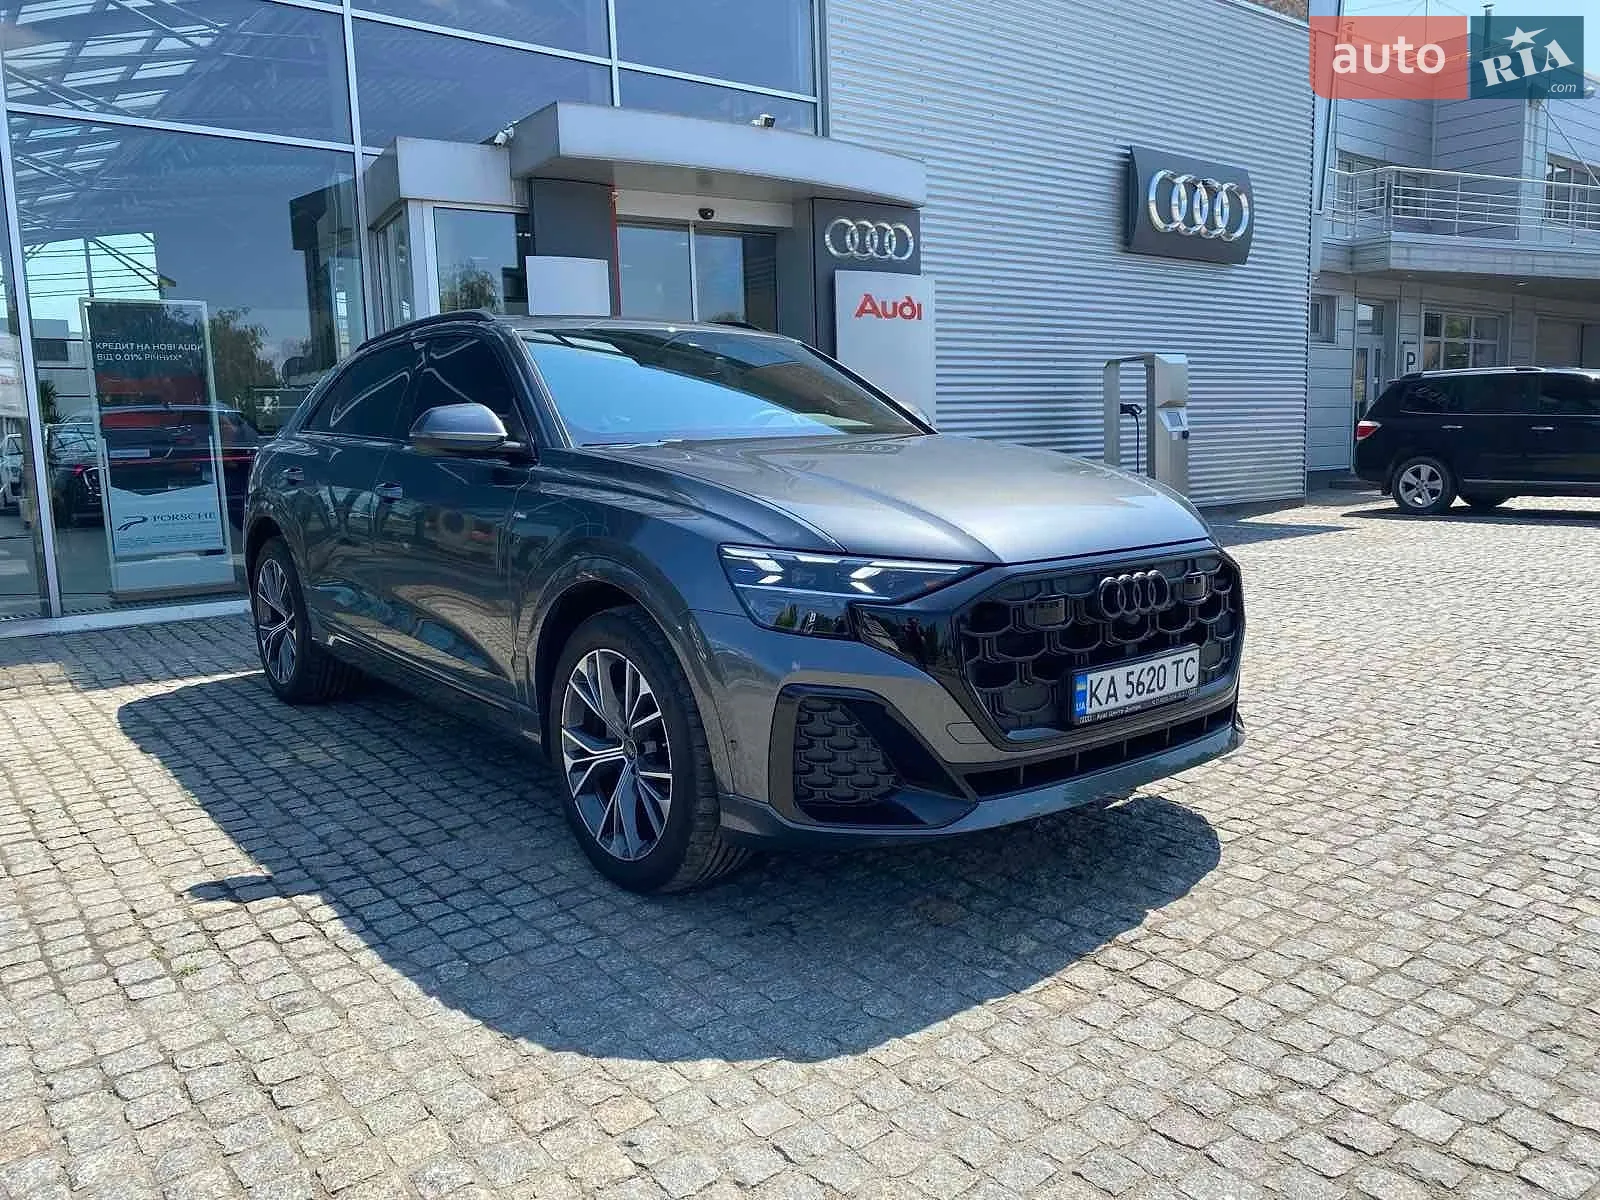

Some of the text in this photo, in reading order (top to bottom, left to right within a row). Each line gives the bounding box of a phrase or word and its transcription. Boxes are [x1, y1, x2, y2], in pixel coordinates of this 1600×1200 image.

[854, 293, 922, 320] Audi
[95, 342, 134, 350] КРЕДИТ
[137, 343, 151, 351] НА
[1406, 351, 1416, 372] P
[1089, 675, 1119, 708] KA
[1125, 664, 1167, 699] 5620
[1172, 657, 1196, 687] TC
[1075, 702, 1086, 712] UA
